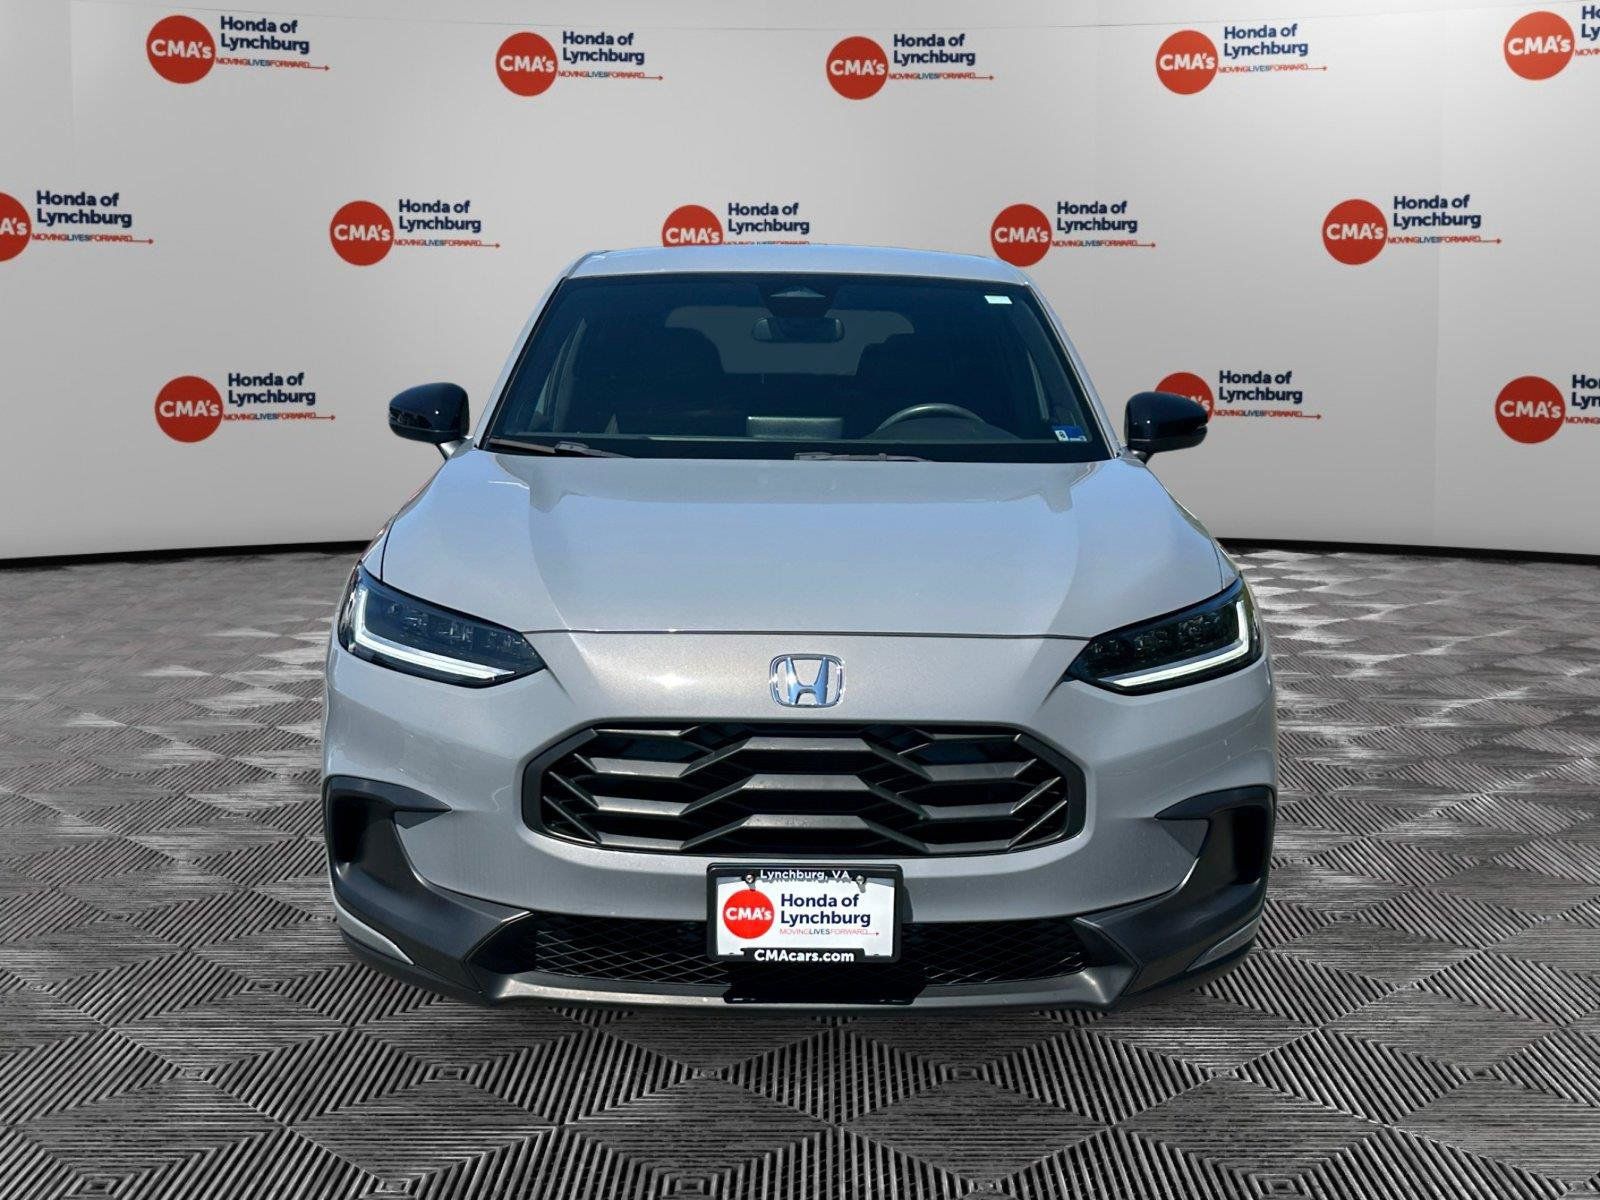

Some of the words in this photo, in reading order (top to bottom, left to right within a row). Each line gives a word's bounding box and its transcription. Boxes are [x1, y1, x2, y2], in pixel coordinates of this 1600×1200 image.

[221, 16, 277, 33] Honda
[280, 20, 298, 34] of
[1224, 25, 1276, 39] Honda
[1280, 24, 1298, 38] of
[221, 33, 310, 55] Lynchburg
[563, 31, 614, 46] Honda
[617, 32, 634, 46] of
[894, 34, 945, 47] Honda
[948, 33, 965, 47] of
[1508, 35, 1572, 56] CMA's
[151, 39, 213, 60] CMA's
[563, 47, 645, 66] Lynchburg
[1224, 41, 1309, 59] Lynchburg
[500, 55, 555, 73] CMA's
[894, 50, 976, 67] Lynchburg
[1159, 53, 1216, 73] CMA's
[830, 60, 885, 76] CMA's
[37, 190, 97, 206] Honda
[100, 192, 119, 207] of
[399, 199, 450, 213] Honda
[453, 200, 470, 214] of
[1394, 195, 1448, 210] Honda
[1452, 194, 1470, 209] of
[728, 202, 779, 216] Honda
[782, 203, 799, 216] of
[1057, 201, 1107, 215] Honda
[1110, 201, 1127, 215] of
[0, 217, 28, 236] A's
[37, 208, 132, 229] Lynchburg
[399, 215, 482, 233] Lynchburg
[728, 218, 810, 235] Lynchburg
[1057, 216, 1138, 234] Lynchburg
[1394, 212, 1482, 230] Lynchburg
[334, 224, 391, 241] CMA's
[666, 227, 721, 244] CMA's
[995, 227, 1049, 244] CMA's
[1326, 223, 1385, 241] CMA's
[228, 372, 284, 387] Honda
[286, 372, 305, 387] of
[1219, 370, 1272, 385] Honda
[1274, 371, 1292, 384] of
[228, 389, 316, 407] Lynchburg
[1219, 386, 1304, 405] Lynchburg
[160, 400, 220, 418] CMA's
[1500, 400, 1562, 419] CMA's
[760, 869, 828, 880] Lynchburg,
[832, 870, 850, 879] VA
[781, 893, 837, 907] Honda
[841, 893, 860, 907] of
[725, 907, 772, 921] CMA's
[780, 911, 871, 927] Lynchburg
[754, 949, 855, 962] CMAcars.com
